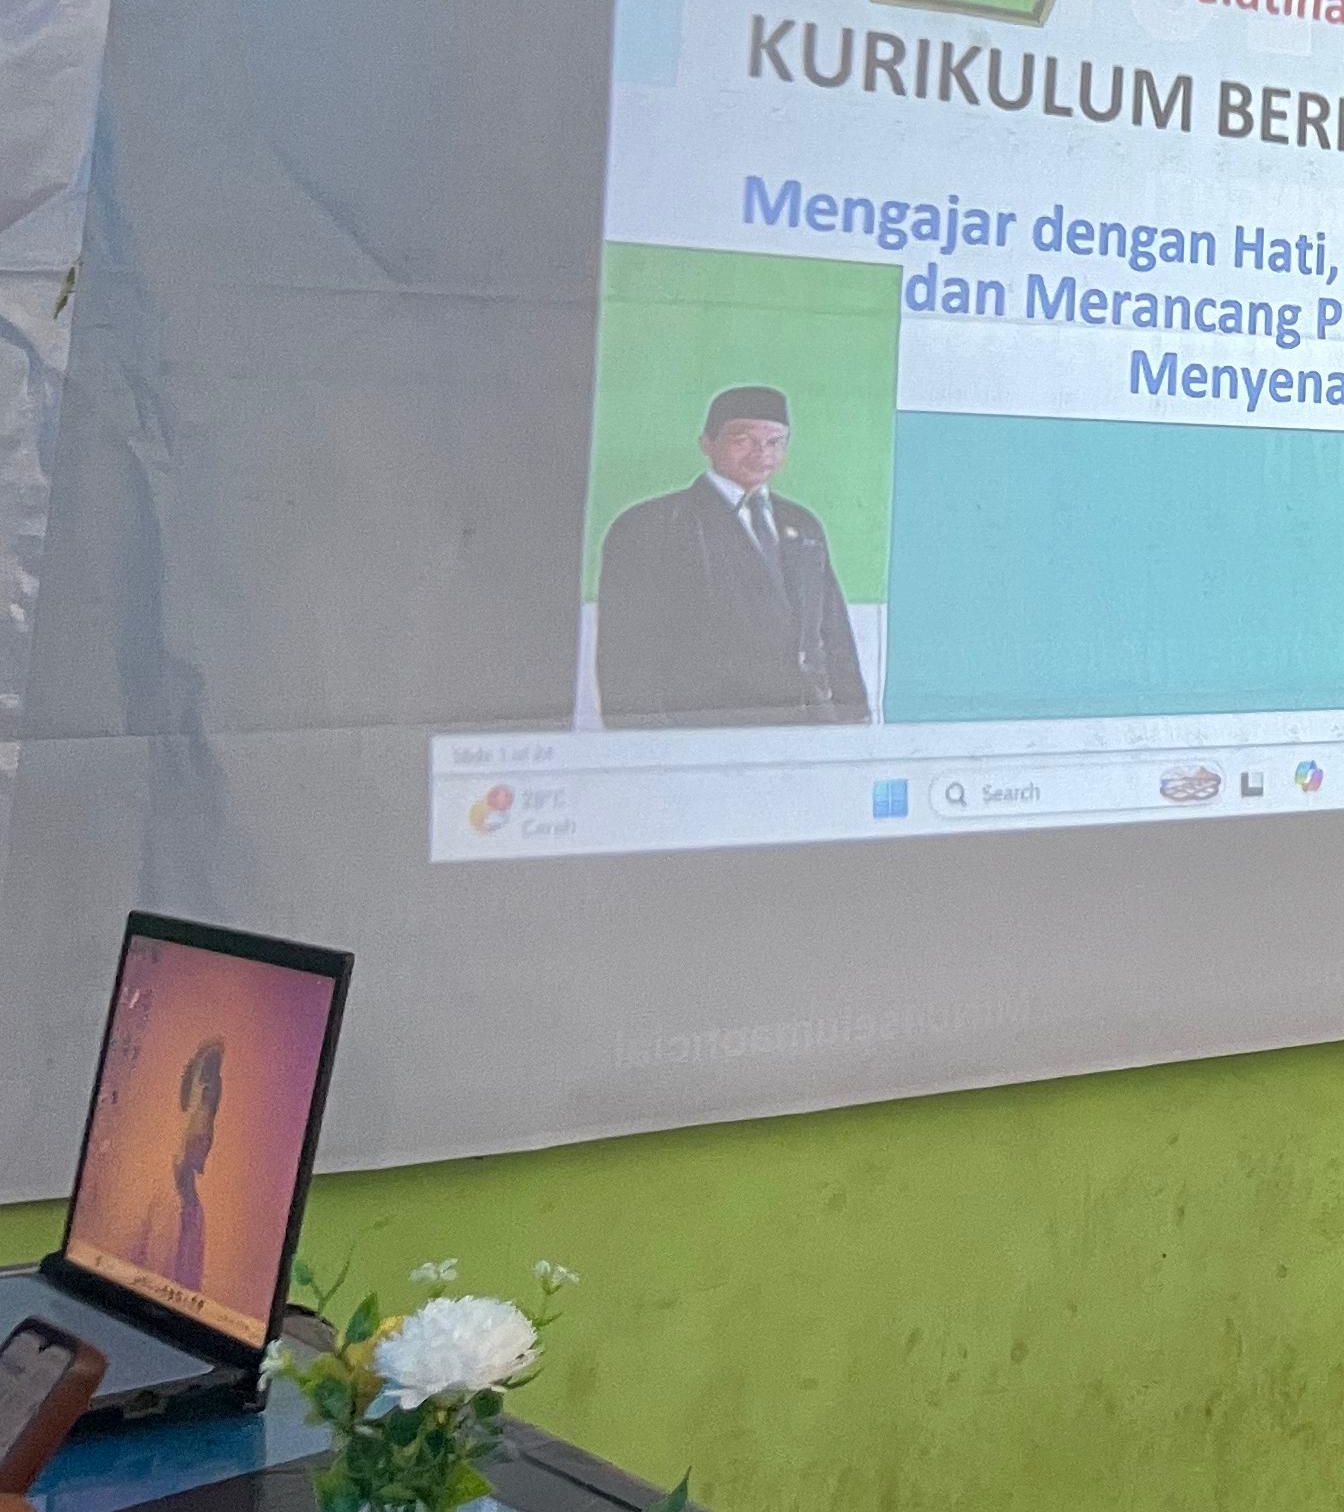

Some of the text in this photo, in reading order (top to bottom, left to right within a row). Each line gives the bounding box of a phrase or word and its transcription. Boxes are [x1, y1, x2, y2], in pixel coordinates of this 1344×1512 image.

[748, 13, 1194, 134] KURIKULUM
[743, 175, 1017, 256] Mengajar
[1032, 204, 1217, 273] dengan
[1234, 225, 1339, 285] Hati,
[905, 262, 1007, 316] dan
[1026, 274, 1301, 349] Merancang
[981, 780, 1041, 803] Search
